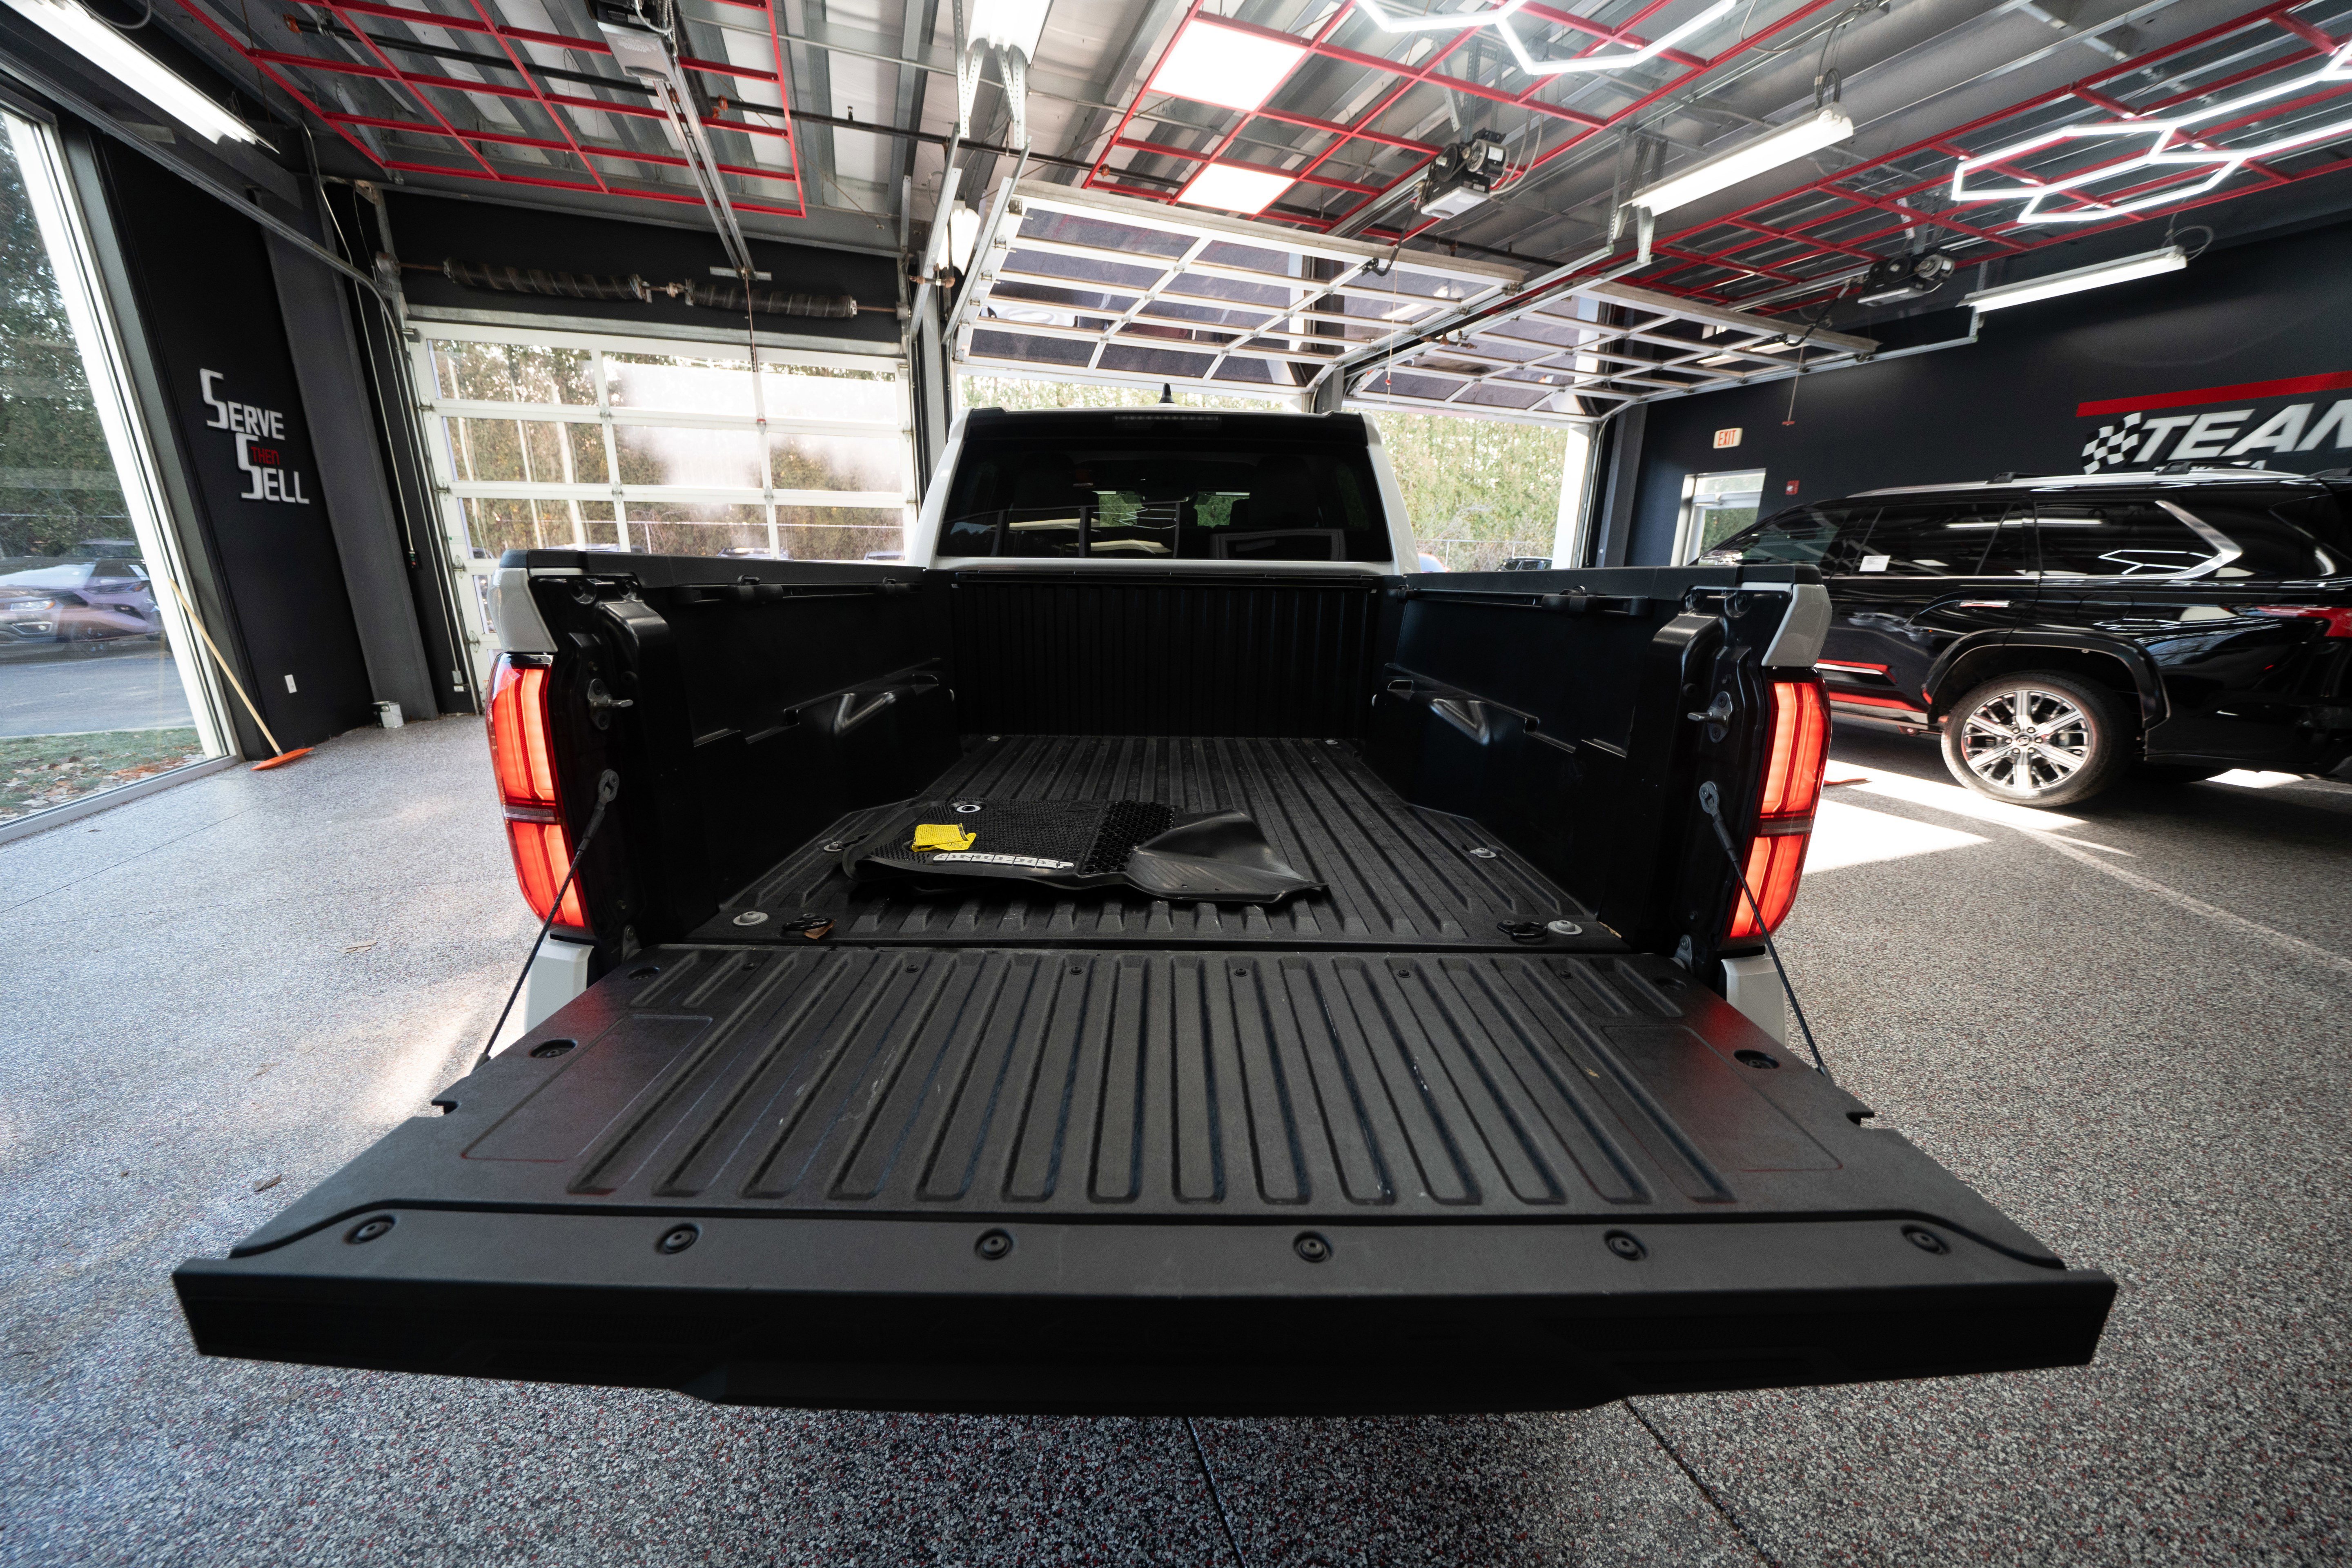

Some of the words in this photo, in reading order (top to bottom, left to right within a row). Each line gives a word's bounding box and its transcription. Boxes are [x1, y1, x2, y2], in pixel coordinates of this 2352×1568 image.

[200, 368, 285, 441] SERVE
[250, 446, 280, 465] THEN
[1717, 430, 1737, 446] EXIT
[235, 432, 310, 504] SELL
